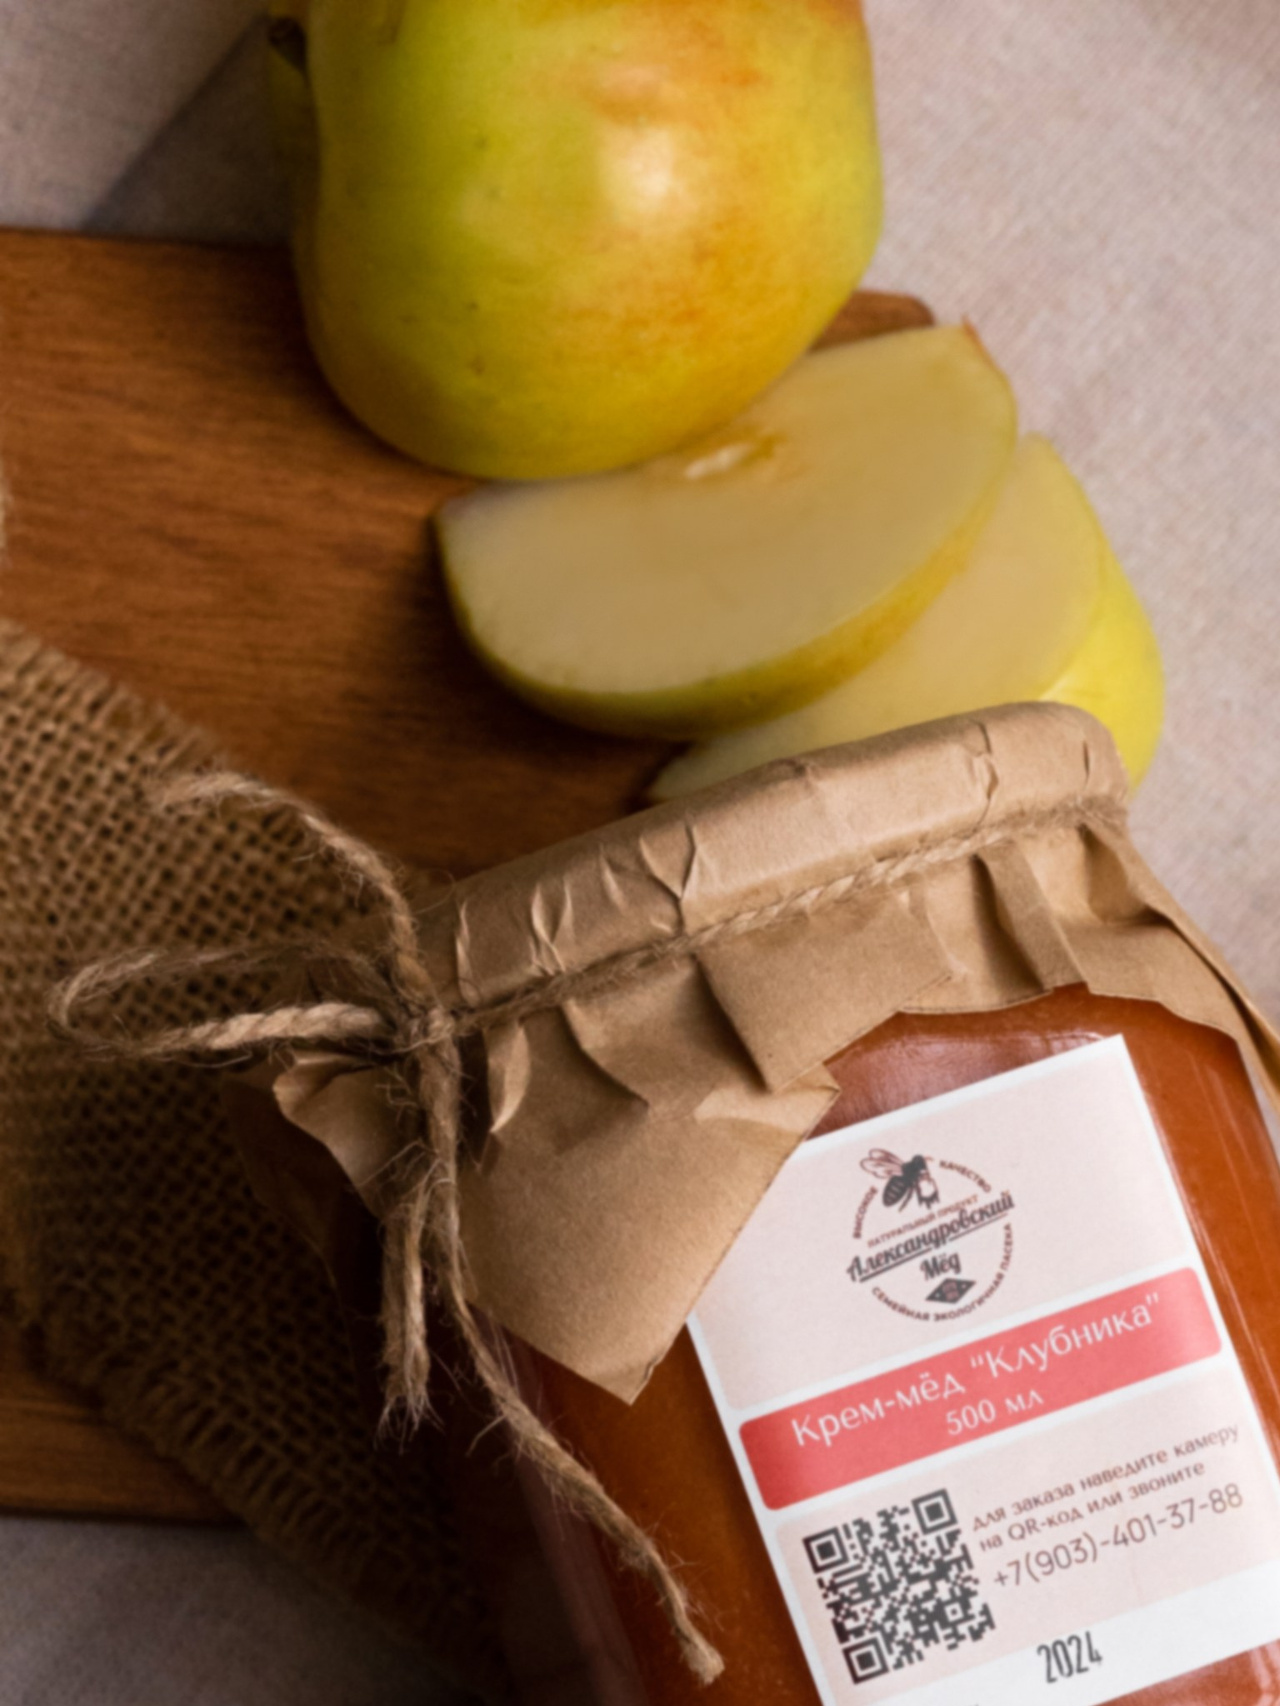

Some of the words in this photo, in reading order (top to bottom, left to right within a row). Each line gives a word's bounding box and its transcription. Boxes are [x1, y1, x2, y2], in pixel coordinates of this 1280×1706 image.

[846, 1189, 1015, 1283] Александровский
[853, 1185, 878, 1239] ВЫСОКОЕ
[939, 1160, 992, 1193] КАЧЕСТВО
[867, 1211, 936, 1248] НАТУРАЛЬНЫЙ
[937, 1194, 979, 1217] ПРОДУКТ
[872, 1286, 930, 1321] СЕМЕЙНАЯ
[934, 1272, 1004, 1322] ЭКОЛОГИЧНАЯ
[1000, 1223, 1013, 1271] ПАСЕКА
[920, 1252, 961, 1281] Мёд
[790, 1373, 966, 1448] Крем-мёд
[971, 1292, 1160, 1378] "Клубника"
[945, 1400, 997, 1436] 500
[1005, 1388, 1044, 1415] мл
[973, 1507, 1006, 1531] для
[1013, 1483, 1075, 1515] заказа
[1080, 1449, 1168, 1491] наведите
[1173, 1423, 1239, 1458] камеру
[980, 1532, 1003, 1551] на
[1007, 1506, 1084, 1541] QR-код
[1087, 1490, 1123, 1513] или
[1129, 1462, 1206, 1500] звоните
[994, 1482, 1243, 1586] +7(903)-401-37-88
[1036, 1631, 1103, 1684] 2024
